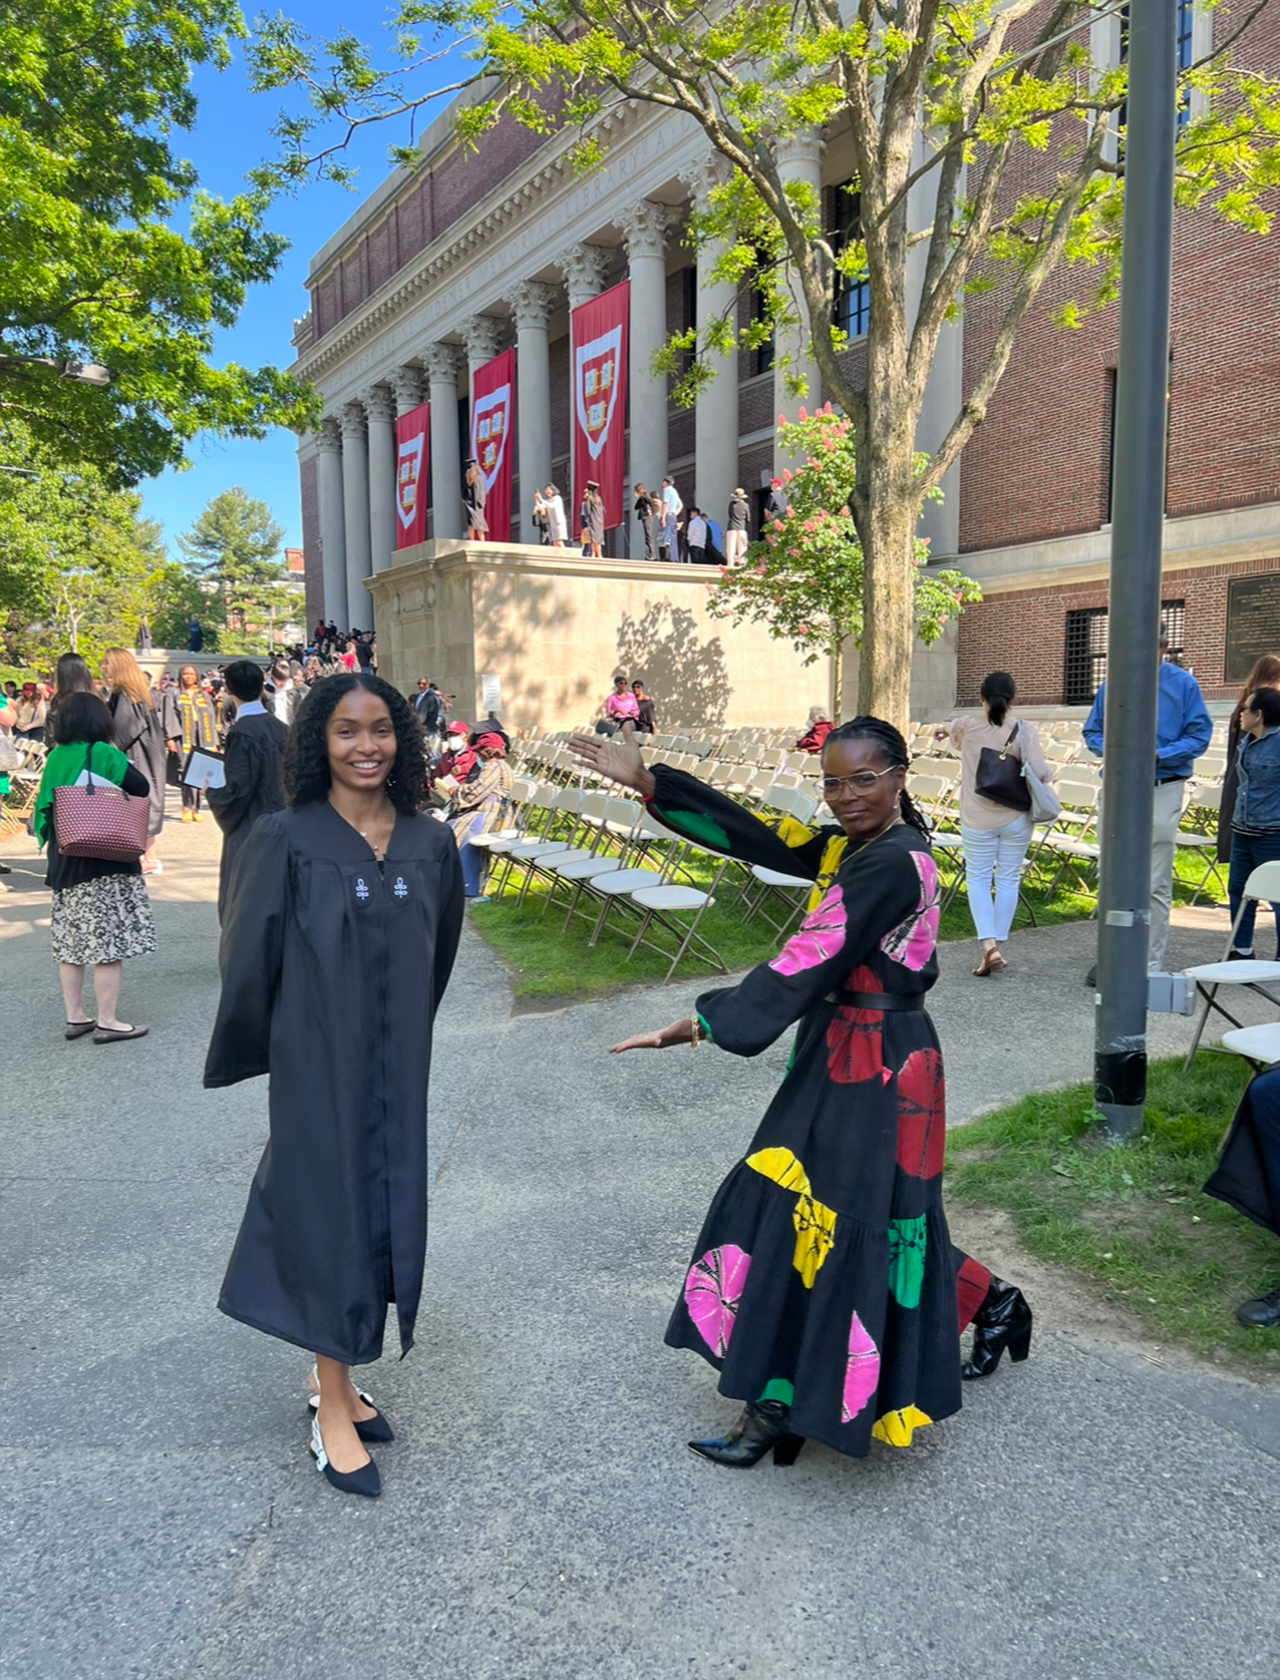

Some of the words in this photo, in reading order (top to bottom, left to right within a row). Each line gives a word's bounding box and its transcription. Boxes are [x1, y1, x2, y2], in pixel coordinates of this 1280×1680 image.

[420, 277, 474, 321] WIDENER
[479, 214, 556, 283] MEMORIAL
[565, 147, 640, 219] LIBRARY
